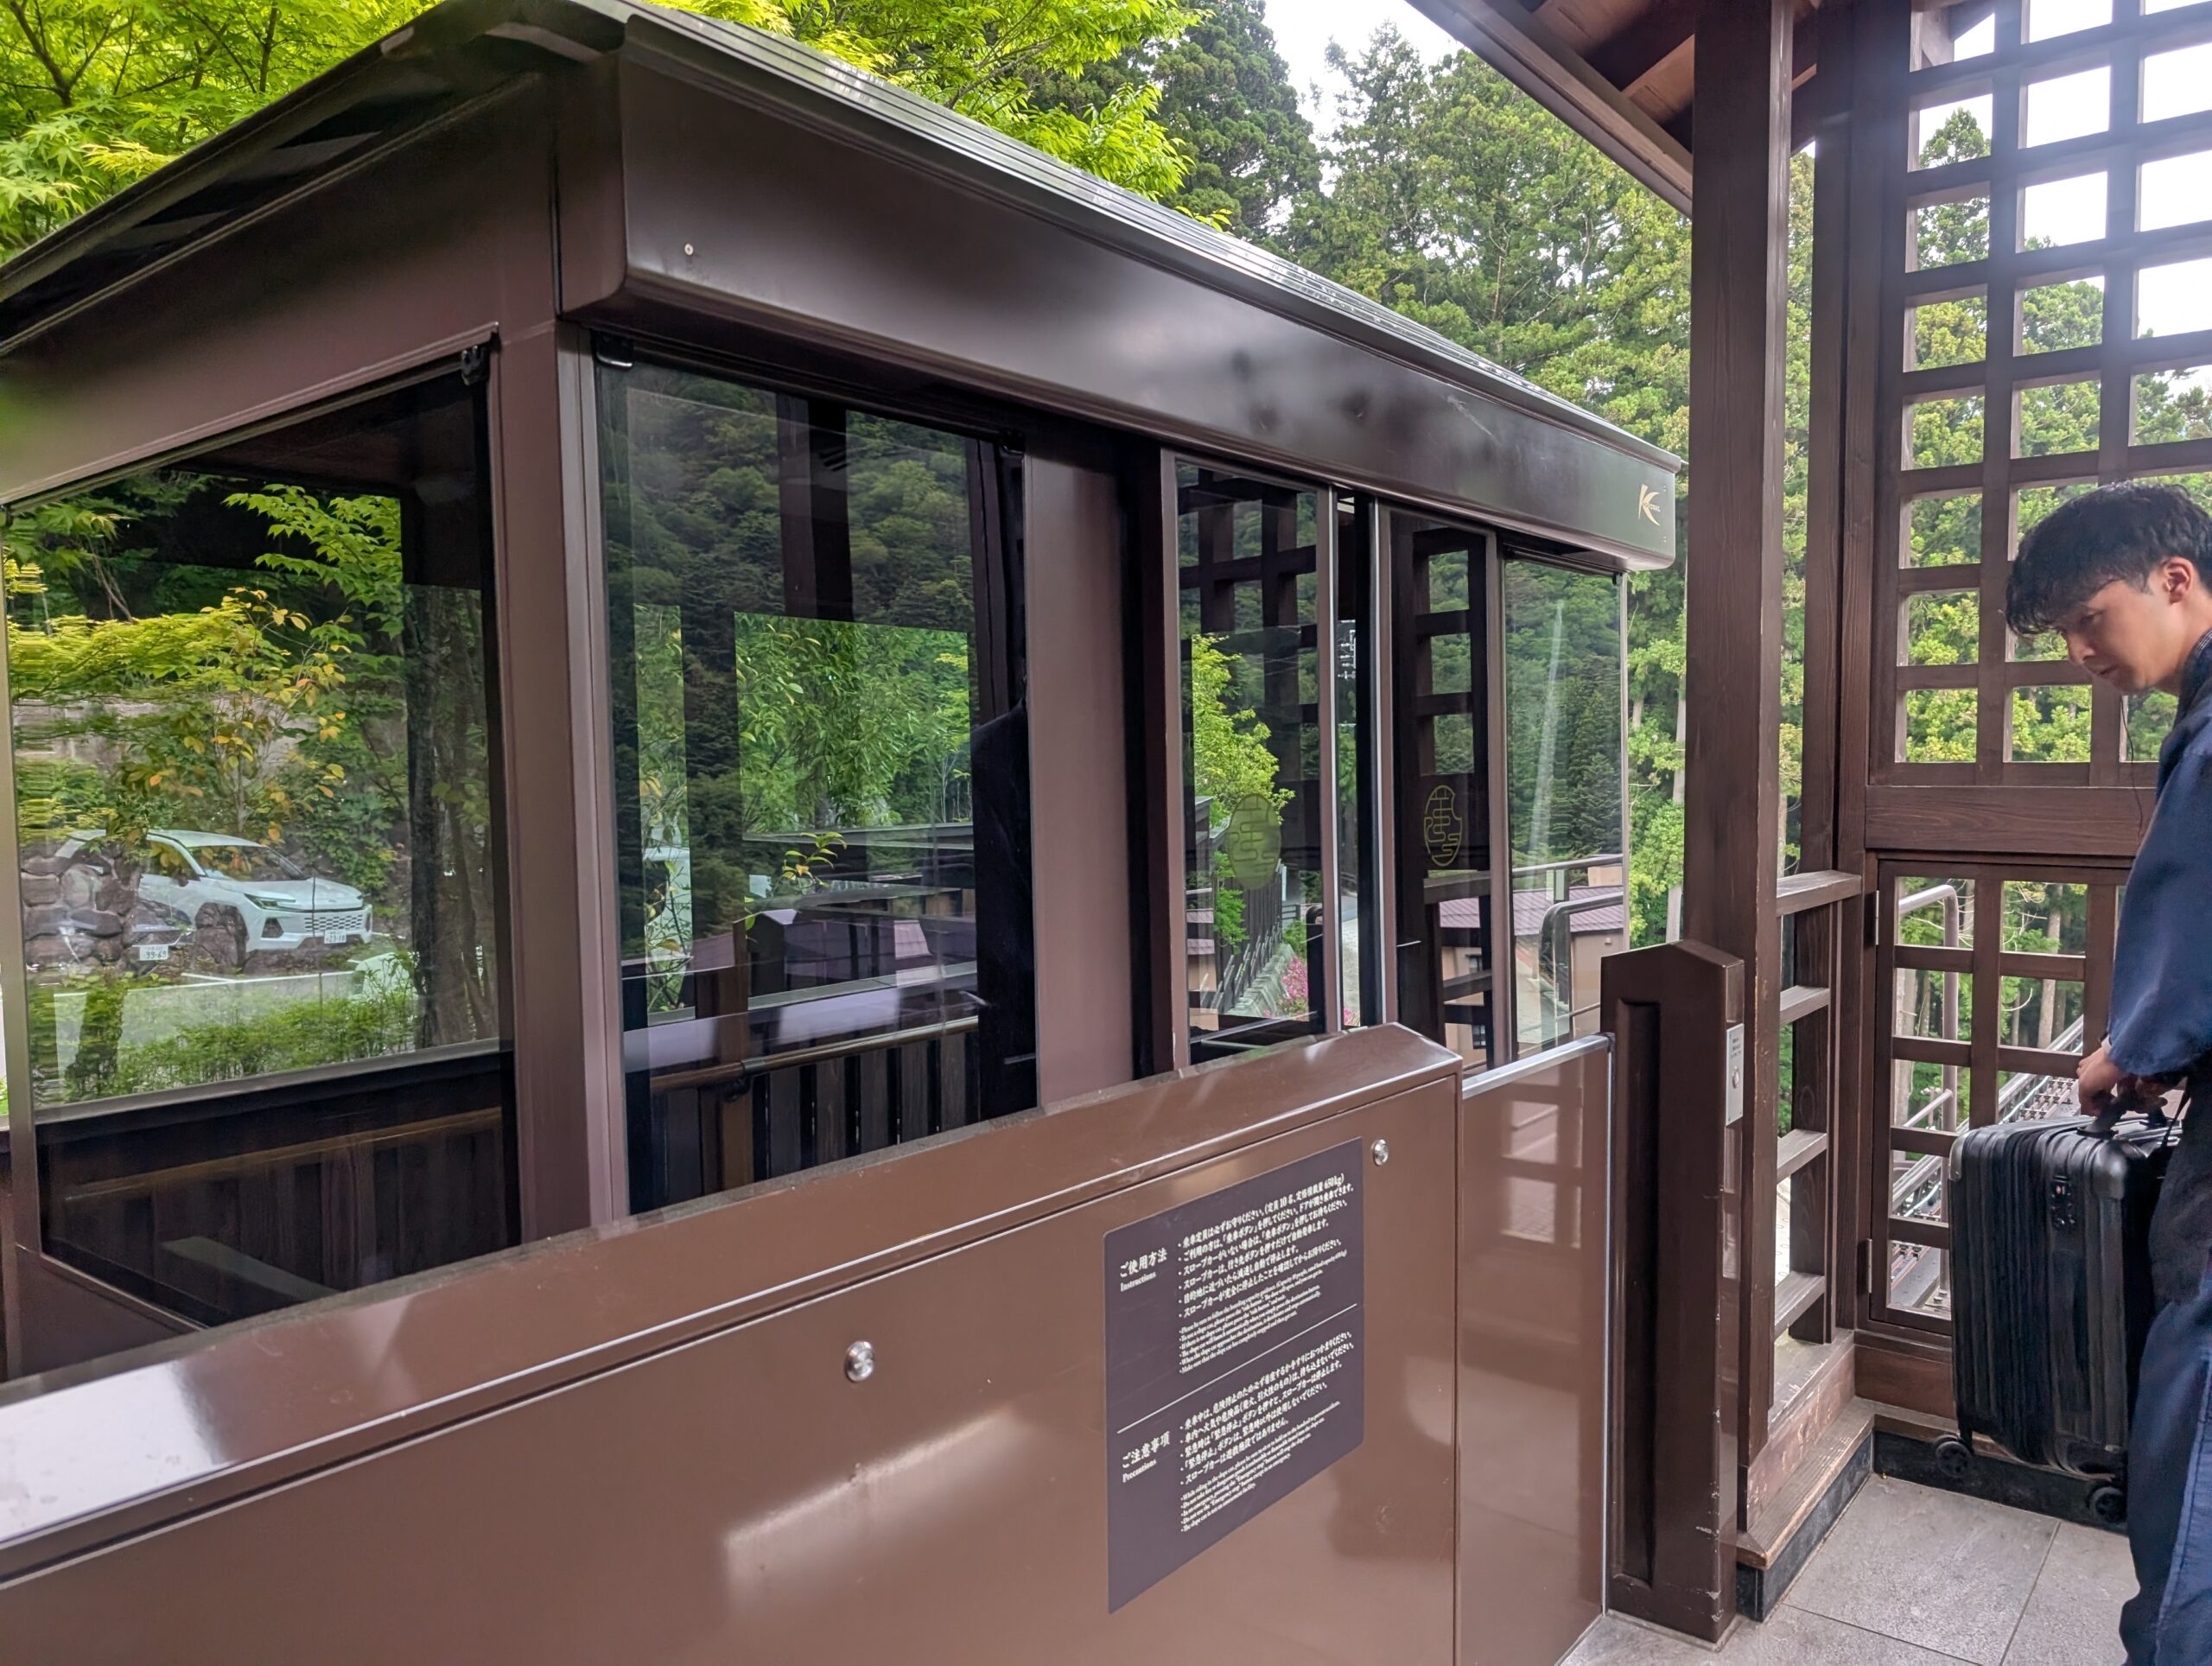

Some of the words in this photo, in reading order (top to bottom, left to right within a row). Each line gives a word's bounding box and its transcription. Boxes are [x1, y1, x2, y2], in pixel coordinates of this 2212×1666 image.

[1120, 1247, 1167, 1277] ご使用方法
[1120, 1271, 1156, 1292] Instructions
[1122, 1430, 1170, 1468] ご注意事項
[1122, 1459, 1156, 1483] Precautions
